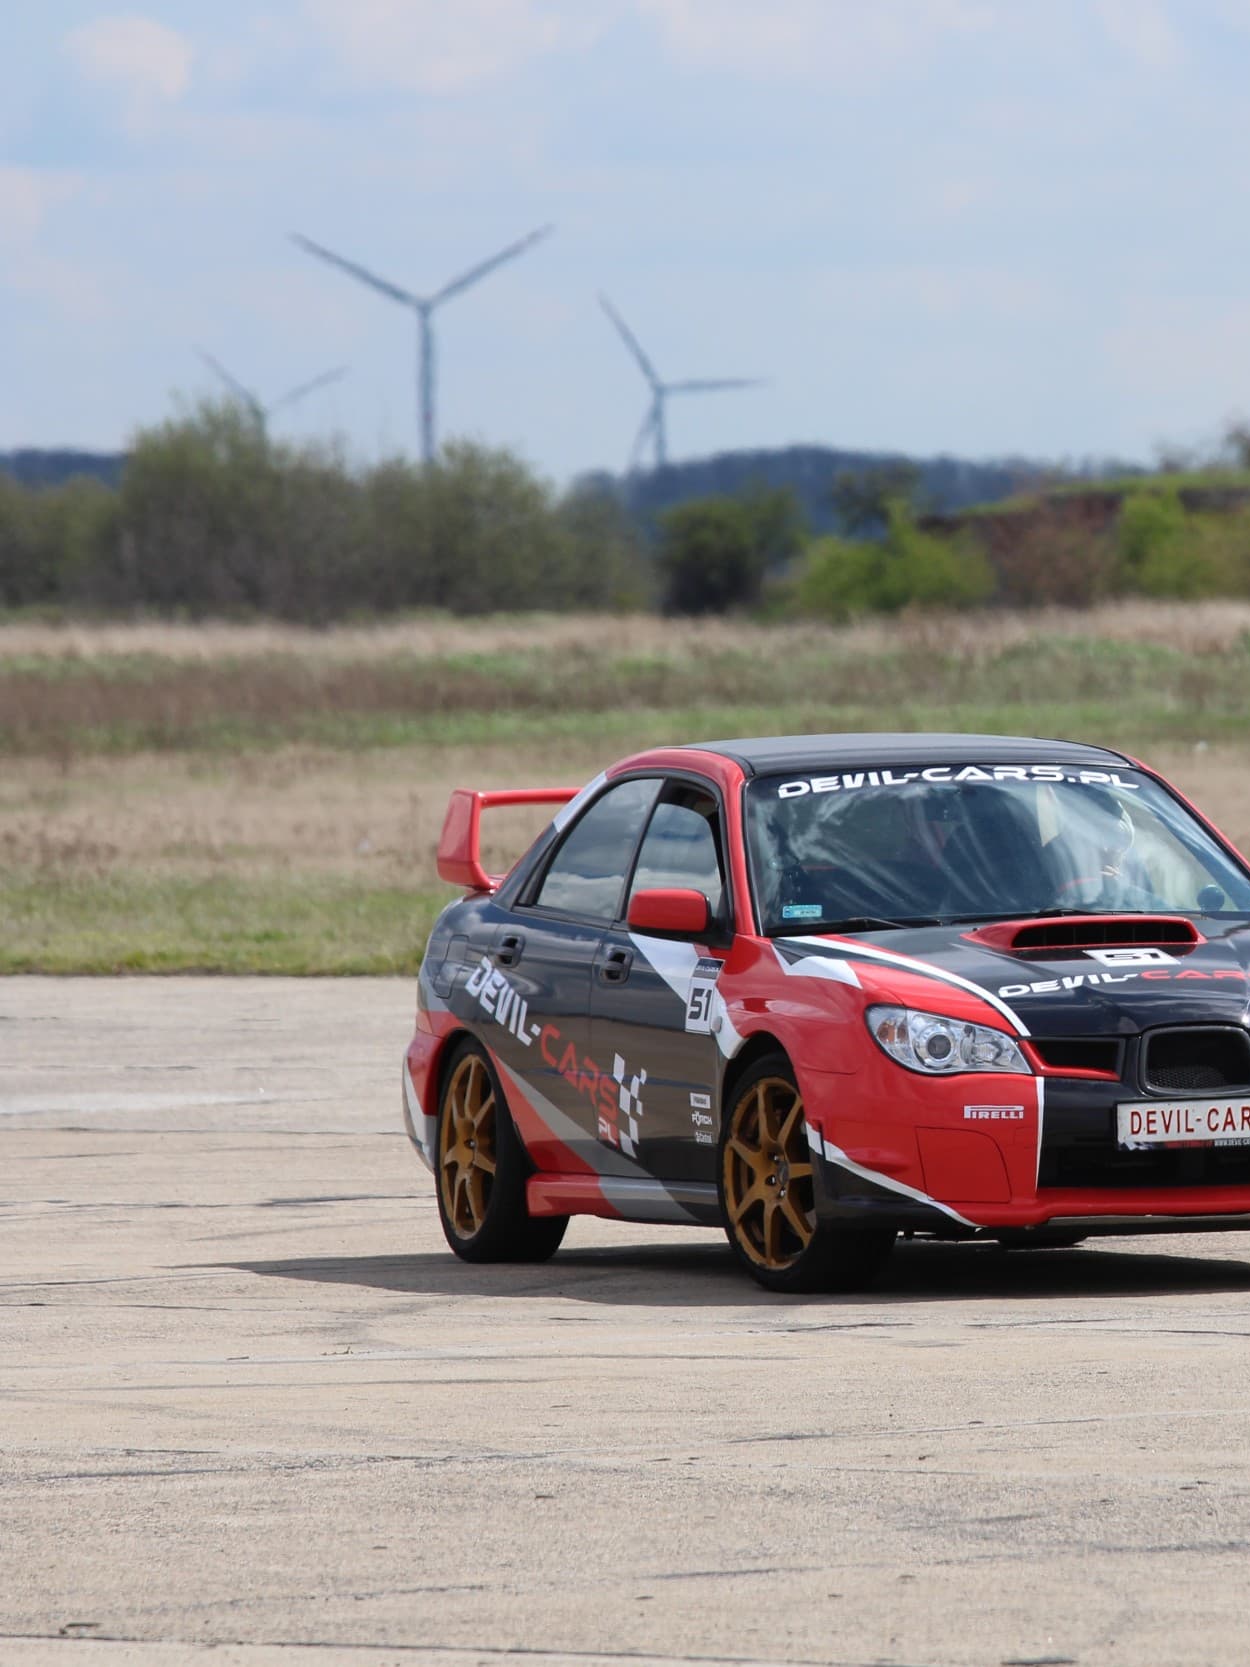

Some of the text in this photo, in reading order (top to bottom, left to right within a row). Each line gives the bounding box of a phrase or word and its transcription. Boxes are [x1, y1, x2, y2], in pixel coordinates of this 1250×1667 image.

[778, 765, 1139, 799] DEVIL-CARS.PL
[1103, 951, 1163, 961] 51
[688, 987, 712, 1021] 51
[464, 956, 619, 1121] DEVIL-CARS
[963, 1104, 1025, 1119] PIRELLI
